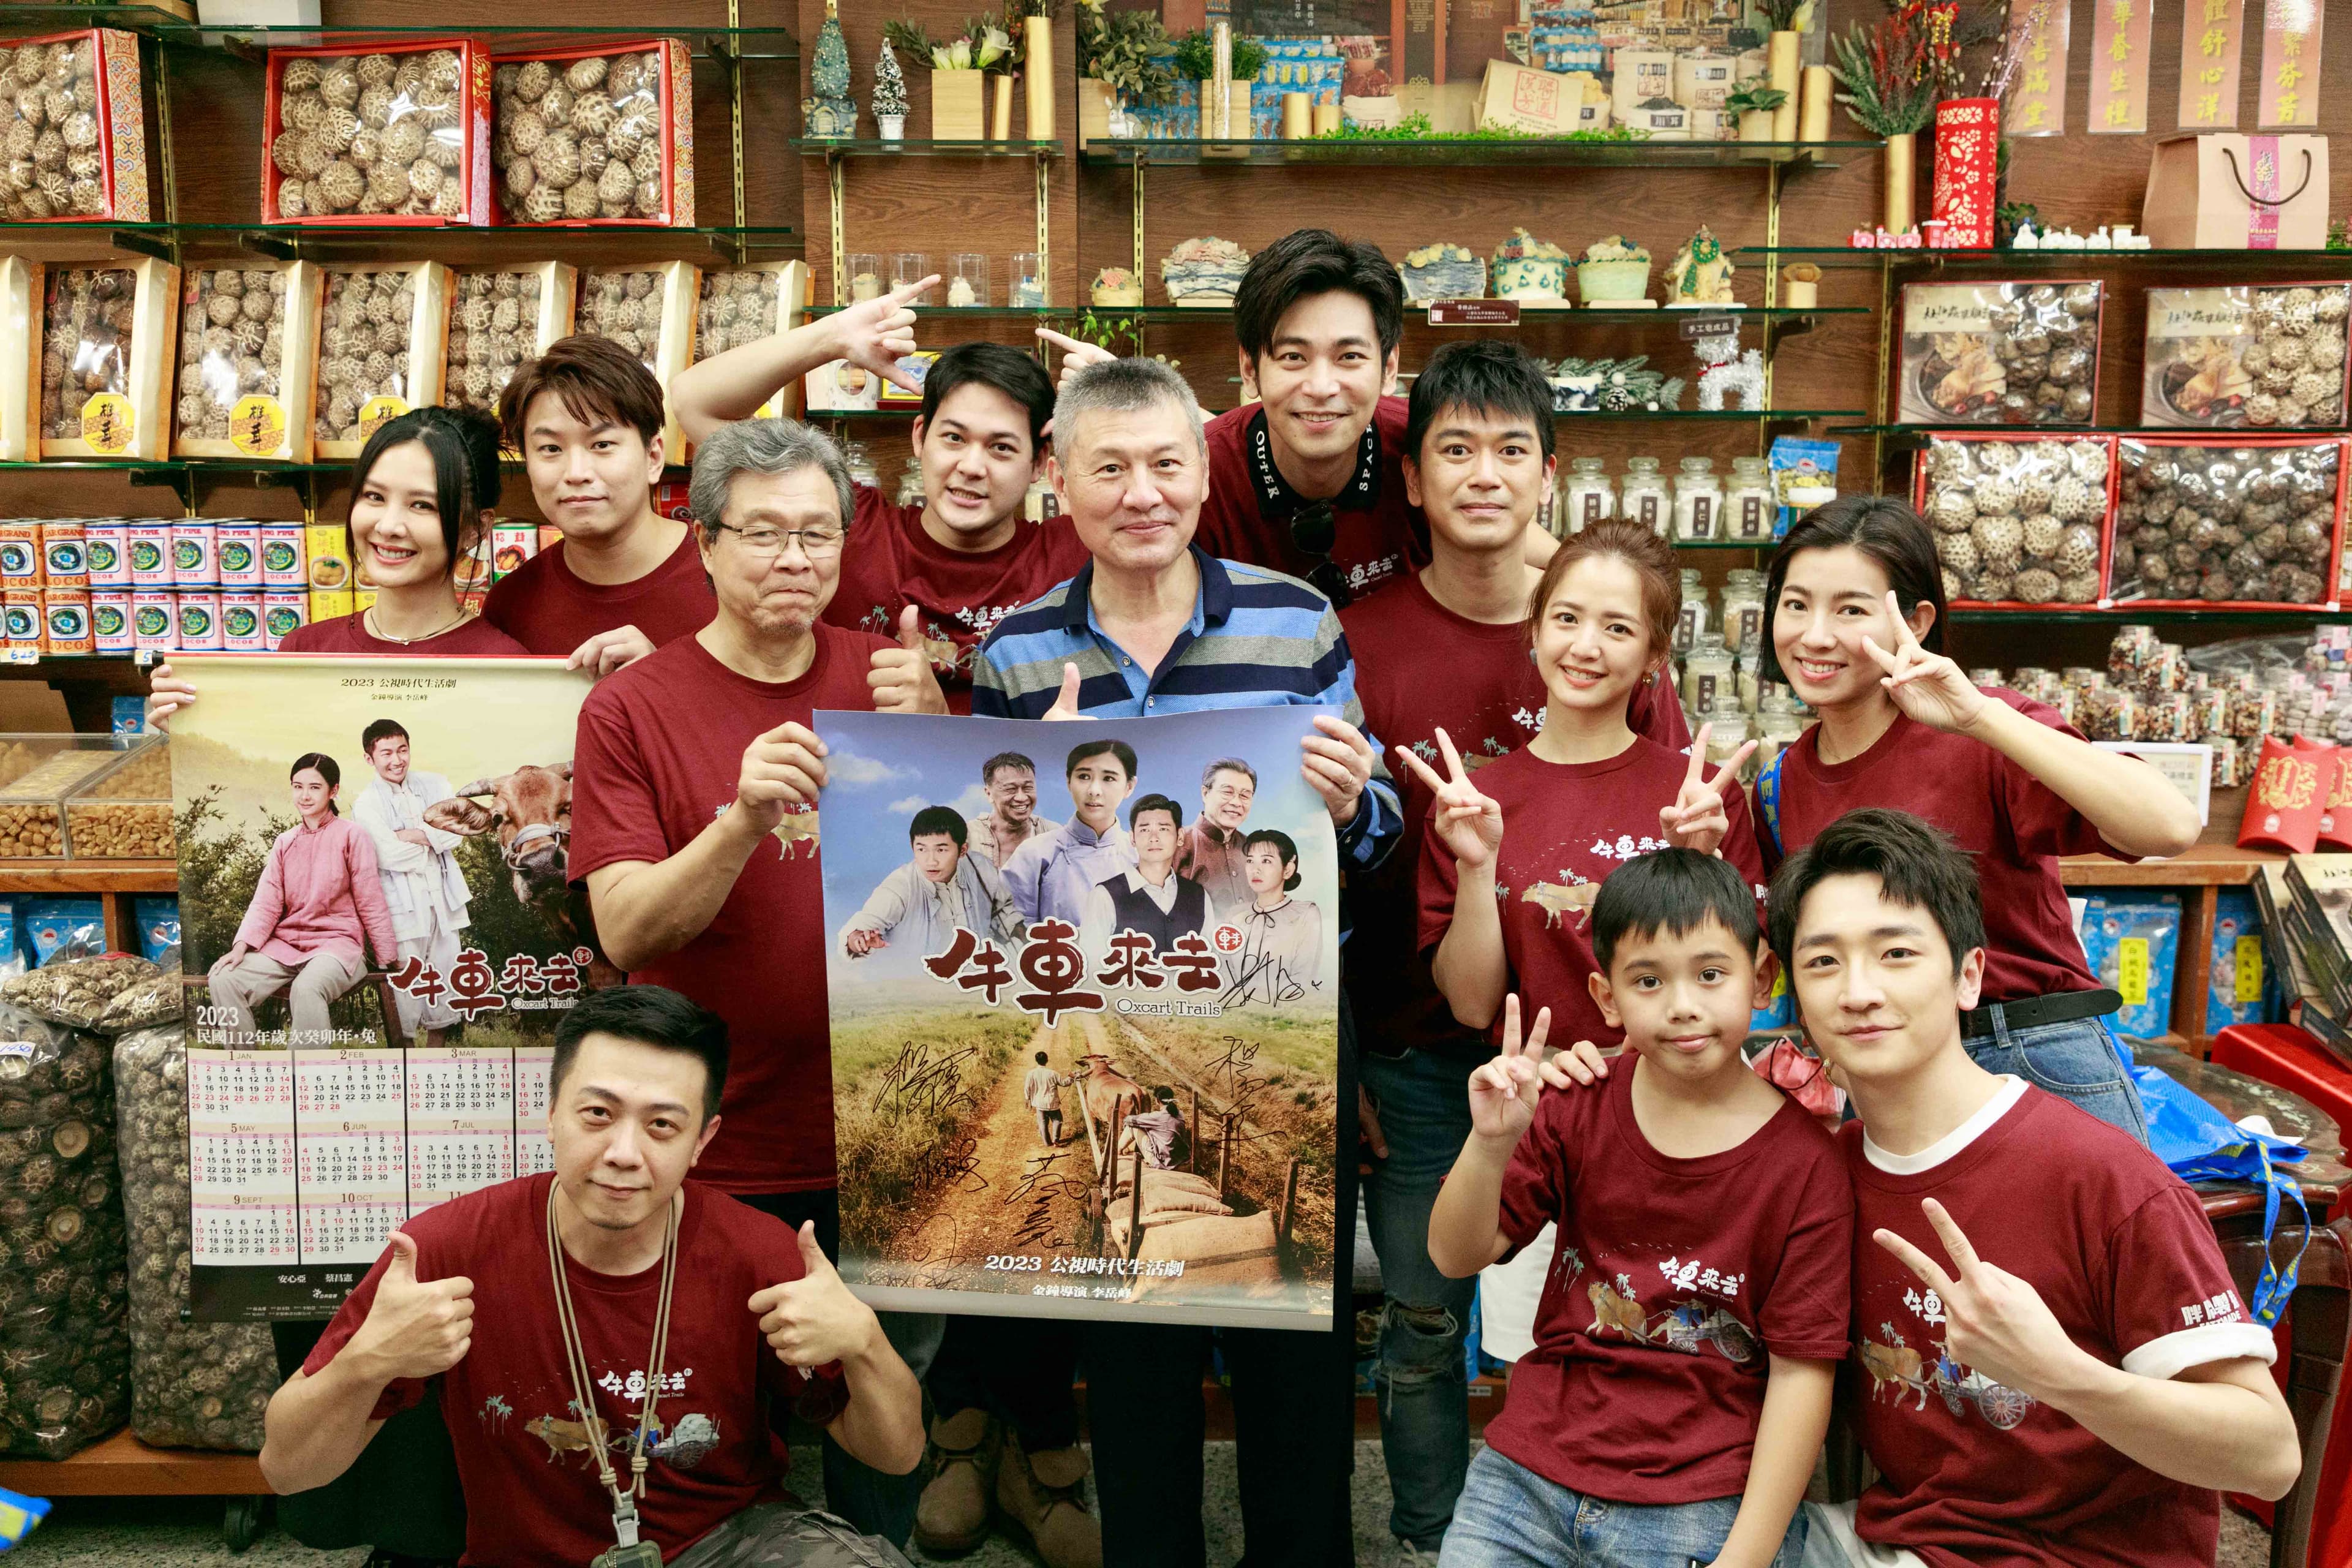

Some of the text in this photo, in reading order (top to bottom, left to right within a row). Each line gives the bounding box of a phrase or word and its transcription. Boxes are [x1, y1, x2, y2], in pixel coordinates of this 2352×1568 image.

[1256, 431, 1281, 499] OUTER
[1345, 557, 1393, 590] 車來去
[380, 678, 456, 688] 公視時代生活劇
[925, 919, 1223, 1026] 牛車來去
[389, 950, 579, 1019] 牛車來去
[513, 999, 546, 1008] Oxcart
[1117, 998, 1220, 1016] Oxcart Trails
[197, 1006, 239, 1026] 2023
[230, 1051, 234, 1060] 1
[341, 1049, 347, 1060] 2
[451, 1049, 458, 1058] 3
[231, 1123, 238, 1133] 5
[343, 1122, 350, 1131] 6
[453, 1120, 459, 1129] 7
[233, 1195, 240, 1204] 9
[341, 1193, 355, 1203] 10
[984, 1255, 1186, 1277] 2023 公視時代生活劇
[1659, 1256, 1738, 1295] 牛車來去
